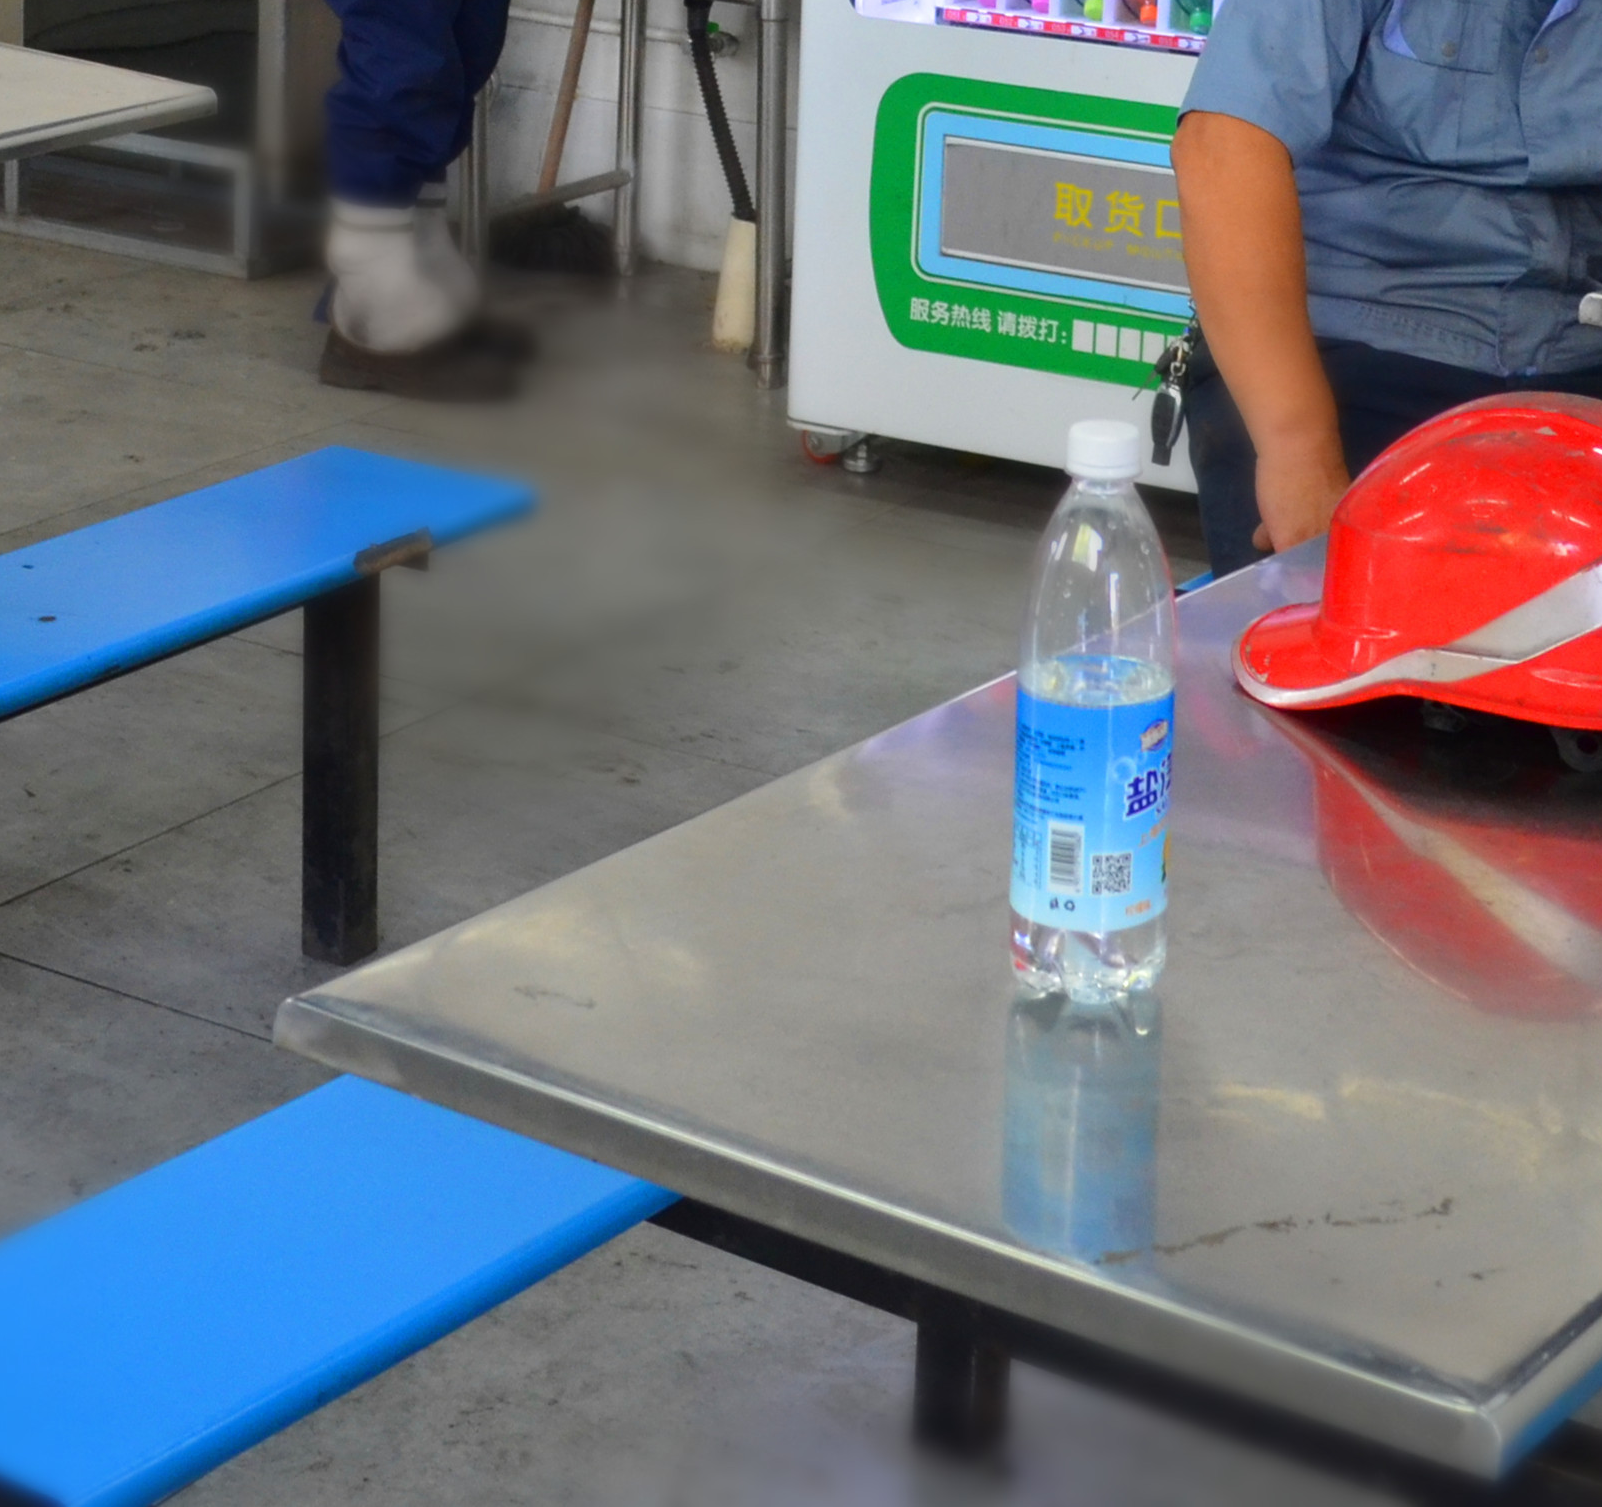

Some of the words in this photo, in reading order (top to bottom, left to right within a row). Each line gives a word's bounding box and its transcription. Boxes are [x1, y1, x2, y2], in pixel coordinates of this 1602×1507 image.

[1054, 182, 1183, 238] 取货口
[910, 297, 992, 333] 服务热线
